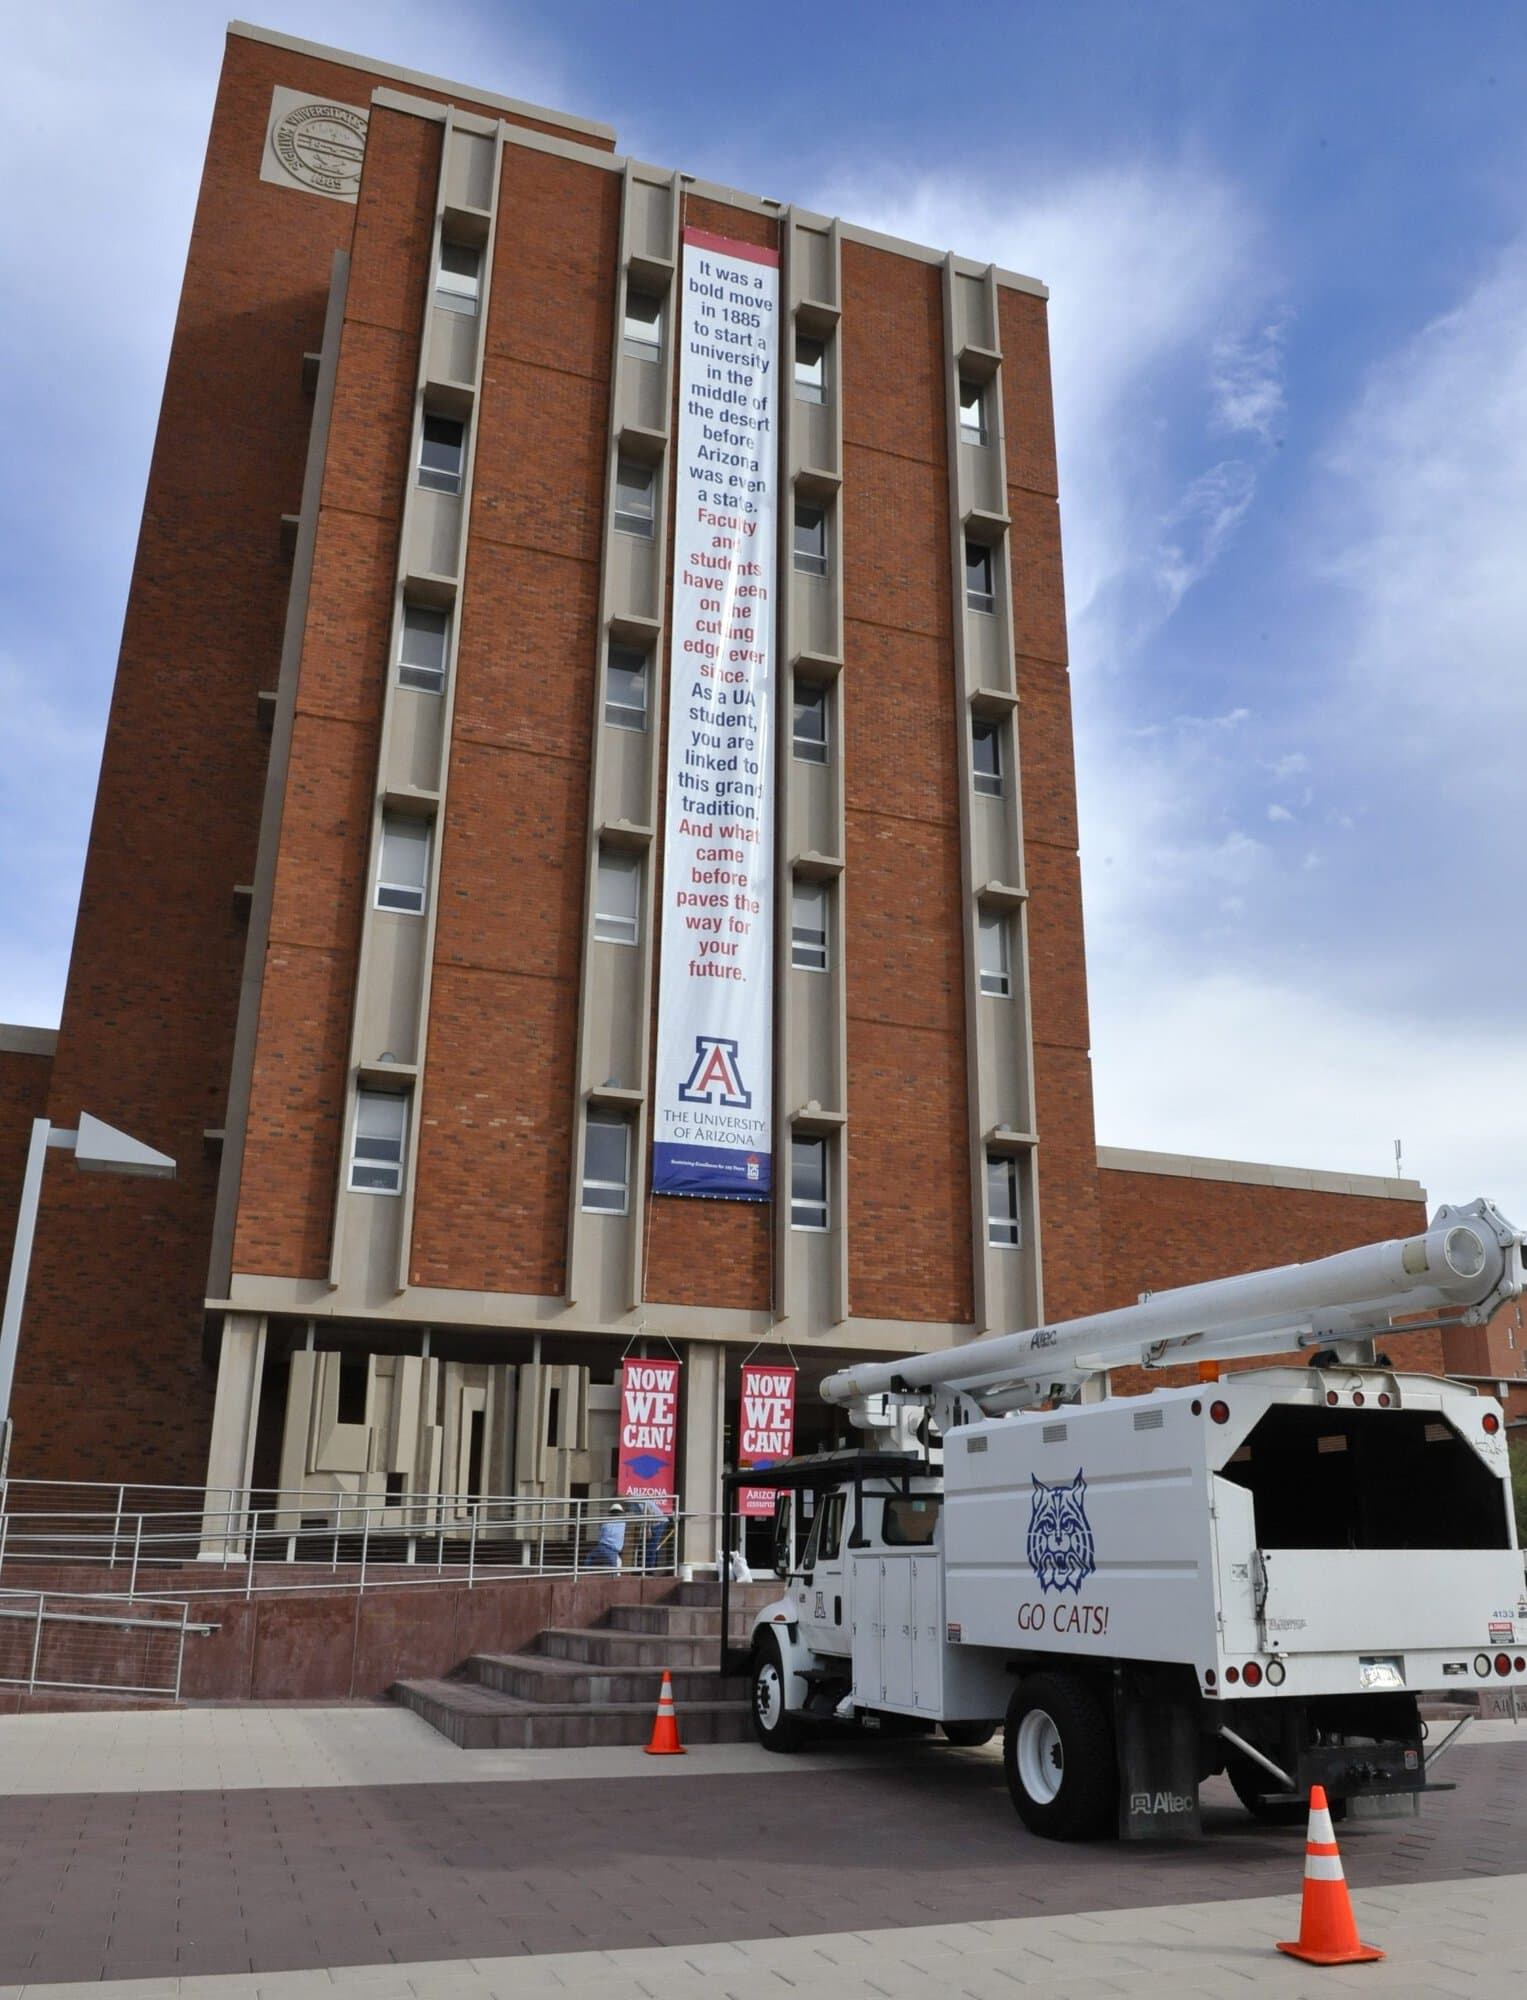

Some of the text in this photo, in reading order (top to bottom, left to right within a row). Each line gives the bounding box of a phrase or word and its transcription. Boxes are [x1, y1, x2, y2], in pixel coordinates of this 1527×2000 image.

[700, 260, 763, 289] It was a
[689, 277, 773, 311] bold move
[701, 301, 760, 328] in 1885
[694, 320, 766, 350] to start a
[690, 342, 770, 374] university
[707, 364, 753, 387] in the
[691, 384, 768, 411] middle of
[688, 401, 770, 432] the desert
[703, 424, 754, 449] before
[697, 445, 759, 472] Arizona
[689, 466, 766, 493] was even
[698, 489, 707, 501] a
[697, 507, 757, 537] Faculty
[711, 535, 741, 552] an
[683, 570, 767, 600] have een
[700, 598, 751, 619] on he
[695, 619, 754, 643] cuting
[729, 649, 765, 665] ever
[691, 682, 756, 707] As a UA
[689, 706, 757, 733] student,
[691, 730, 754, 751] you are
[685, 749, 759, 775] linked to
[678, 771, 709, 792] this
[682, 796, 759, 821] tradition.
[679, 818, 760, 844] And what
[696, 848, 744, 863] came
[691, 867, 748, 887] before
[676, 891, 760, 914] paves the
[685, 916, 751, 935] way for
[699, 940, 739, 957] your
[689, 960, 747, 982] future.
[678, 1035, 752, 1110] A
[664, 1109, 766, 1132] THE UNIVERSITY
[673, 1127, 755, 1146] OF ARIZONA
[626, 1367, 675, 1391] NOW
[745, 1374, 792, 1397] NOW
[624, 1391, 674, 1424] WE
[743, 1398, 791, 1429] WE
[623, 1424, 673, 1451] CAN!
[743, 1430, 791, 1456] CAN!
[626, 1485, 667, 1497] ARIZONA
[1018, 1603, 1109, 1635] GO CATS!
[1153, 1792, 1193, 1814] Altec
